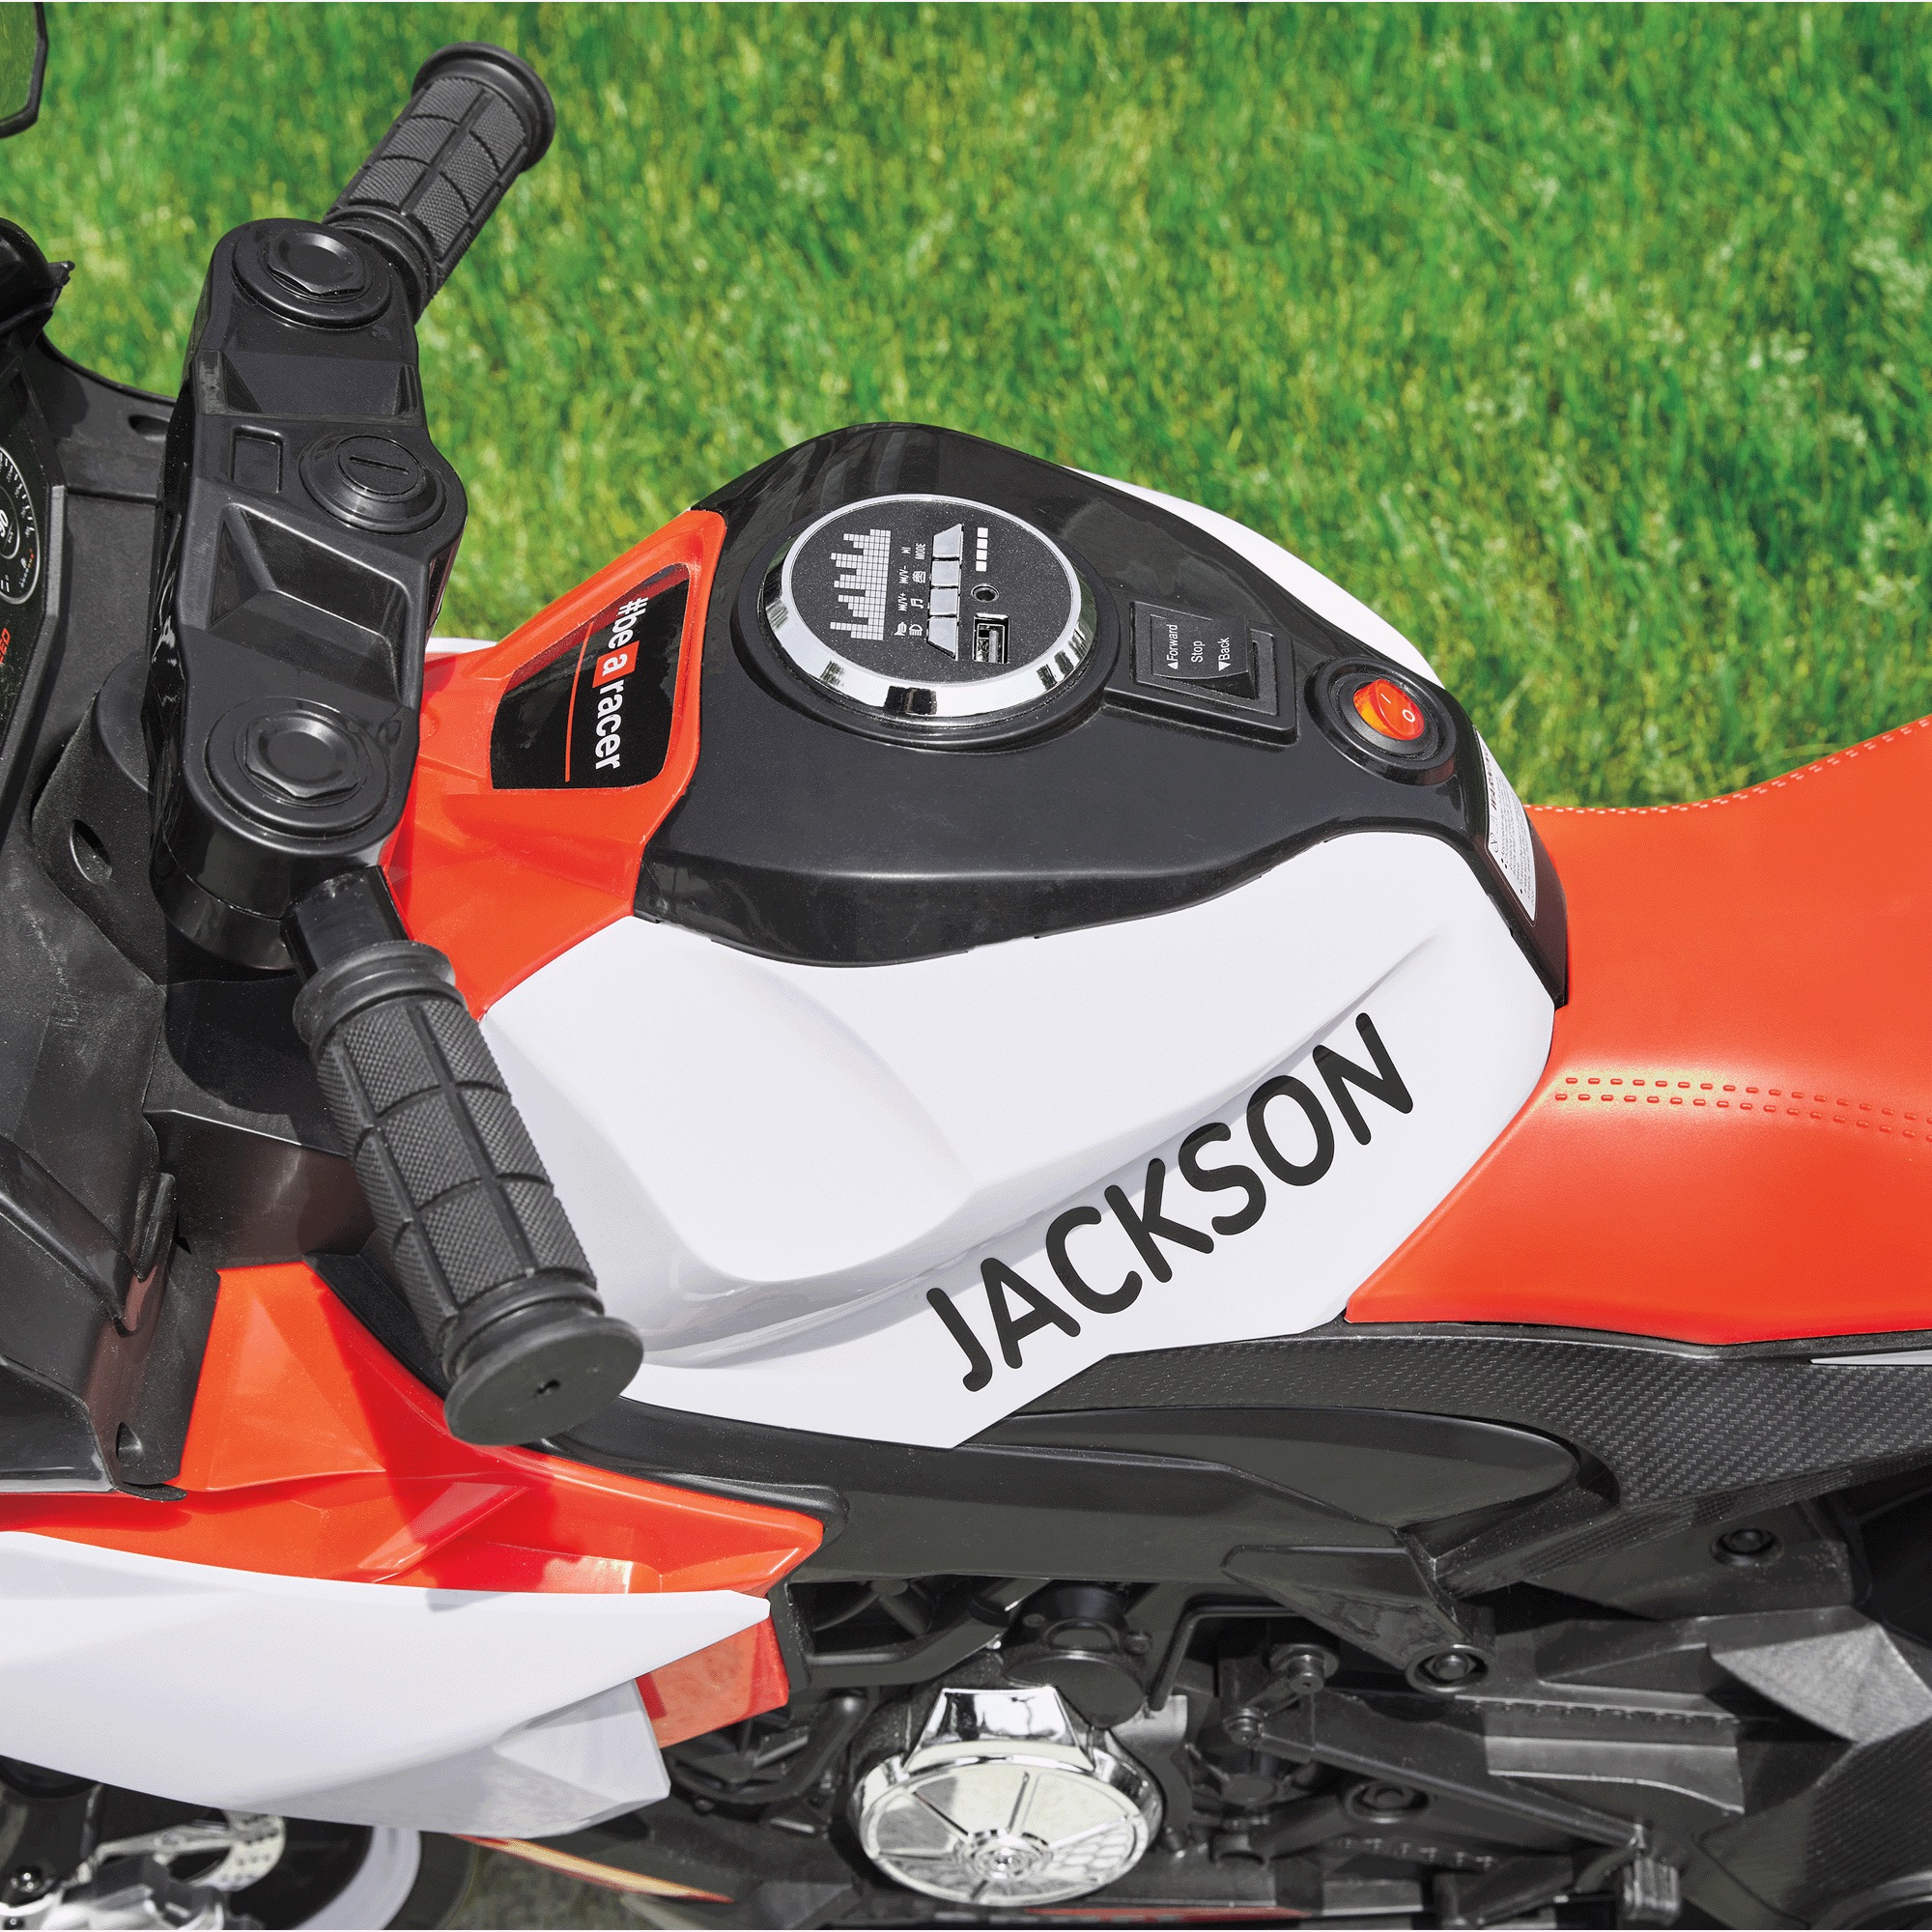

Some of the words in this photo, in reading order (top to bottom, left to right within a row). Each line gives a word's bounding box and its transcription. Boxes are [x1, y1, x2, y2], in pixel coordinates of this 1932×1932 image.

[915, 543, 926, 560] MODE
[608, 597, 649, 650] #be
[1166, 624, 1179, 662] Forward
[1190, 640, 1206, 663] Stop
[1217, 637, 1231, 661] Back
[602, 653, 629, 677] a
[595, 679, 625, 770] racer
[926, 1012, 1413, 1392] JACKSON
